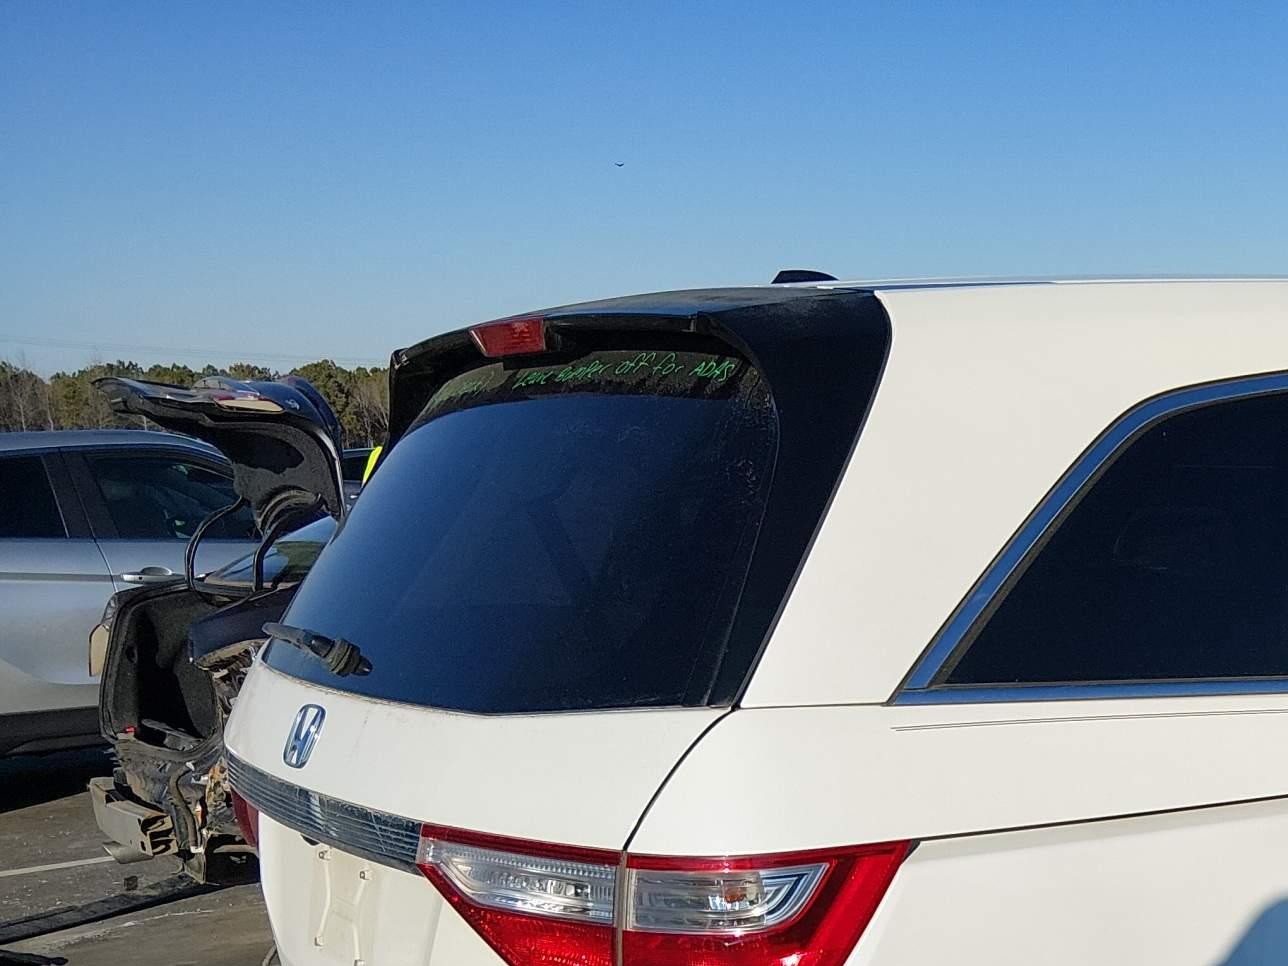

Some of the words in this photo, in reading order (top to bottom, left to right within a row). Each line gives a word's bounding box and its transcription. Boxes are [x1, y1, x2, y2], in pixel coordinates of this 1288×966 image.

[615, 352, 656, 375] off
[653, 352, 686, 376] for
[689, 360, 735, 382] ADAS
